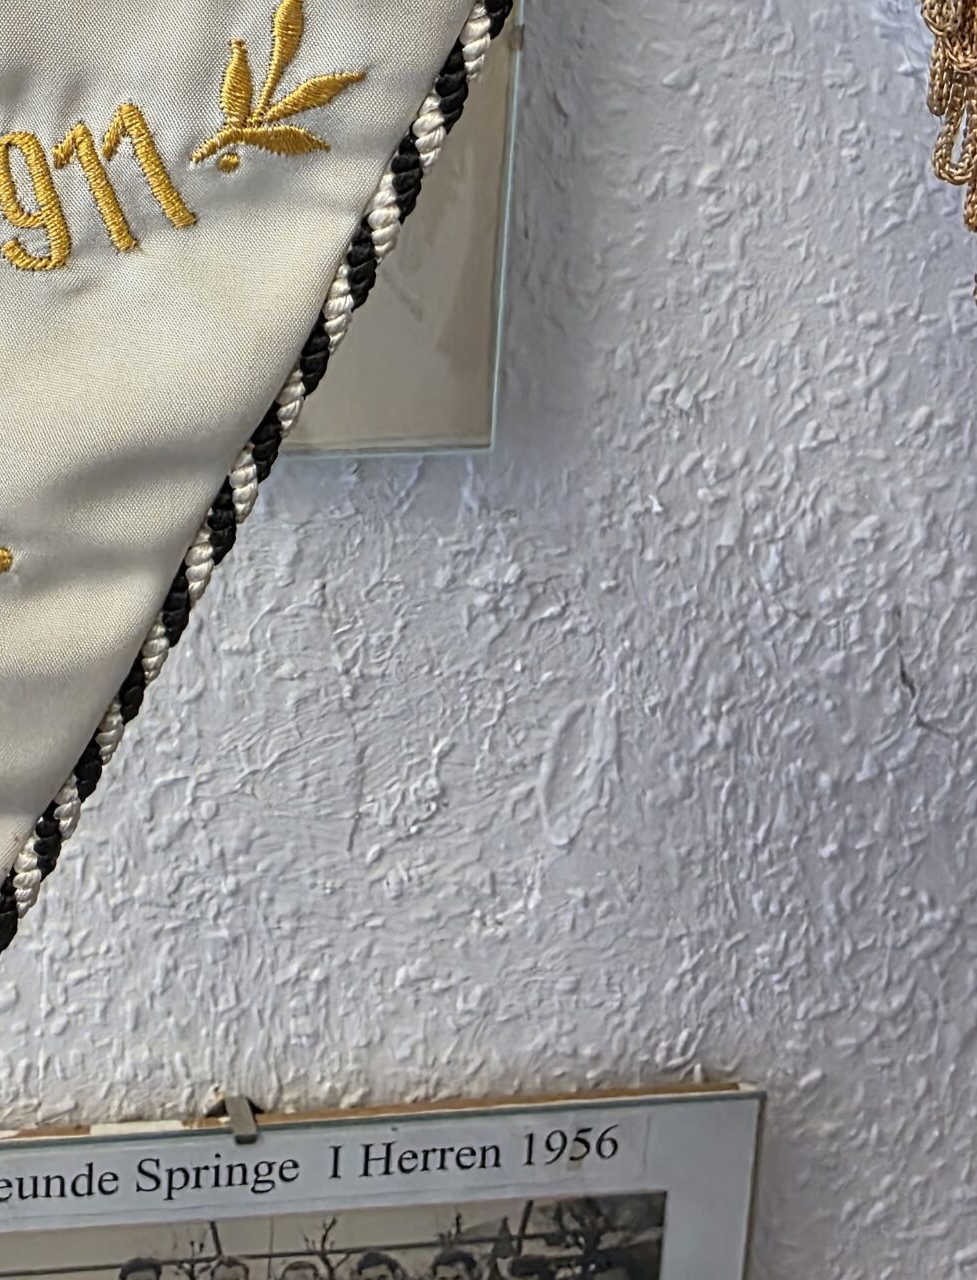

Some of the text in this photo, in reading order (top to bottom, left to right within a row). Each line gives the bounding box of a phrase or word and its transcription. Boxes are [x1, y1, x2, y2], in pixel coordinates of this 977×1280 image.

[135, 1152, 301, 1201] Springe
[327, 1144, 344, 1180] I
[358, 1140, 502, 1179] Herren
[521, 1123, 620, 1167] 1956
